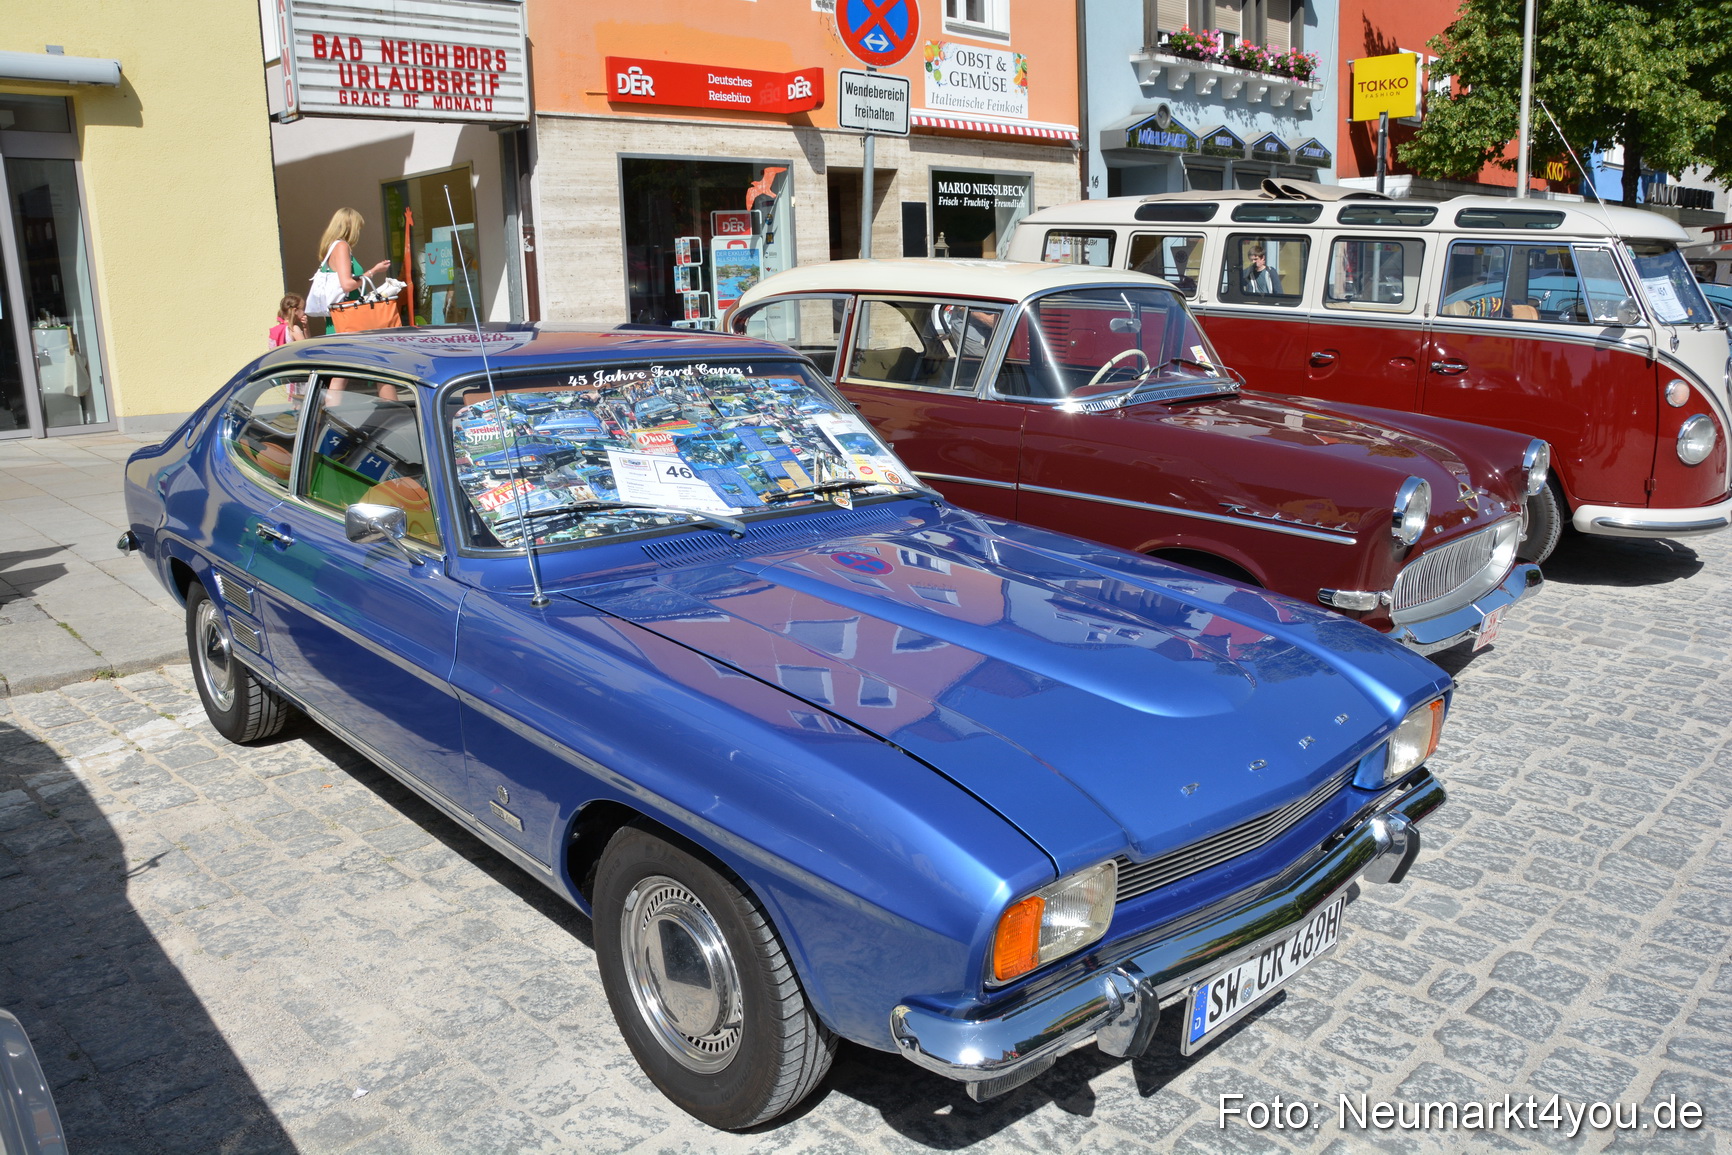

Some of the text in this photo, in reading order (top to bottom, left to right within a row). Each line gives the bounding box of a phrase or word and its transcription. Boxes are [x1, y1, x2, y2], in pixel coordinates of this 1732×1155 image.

[312, 33, 507, 72] BAD NEIGHBORS
[956, 50, 1007, 72] OBST &
[339, 62, 500, 96] URLAUBSREIF
[617, 71, 656, 97] DER
[708, 73, 753, 88] Deutsches
[949, 71, 1008, 93] GEMÜSE
[708, 90, 752, 104] Reisebüro
[787, 80, 813, 100] DER
[845, 81, 905, 102] Wendebereich
[1365, 91, 1401, 99] FASHION
[339, 89, 493, 112] GRACE OF MONACO
[931, 92, 1023, 114] Italienische Feinkost
[855, 104, 895, 122] freihalten
[938, 181, 1025, 197] MARIO NIESSLBECK
[1091, 175, 1100, 189] 16
[938, 196, 959, 206] Frisch
[963, 197, 990, 210] Fruchtig
[994, 199, 1025, 208] Freundlich
[722, 221, 746, 232] DER
[568, 375, 587, 386] 45
[593, 369, 646, 387] Jahre
[651, 365, 693, 378] Ford
[666, 465, 693, 479] 46
[1208, 901, 1340, 1023] SW CR 469H
